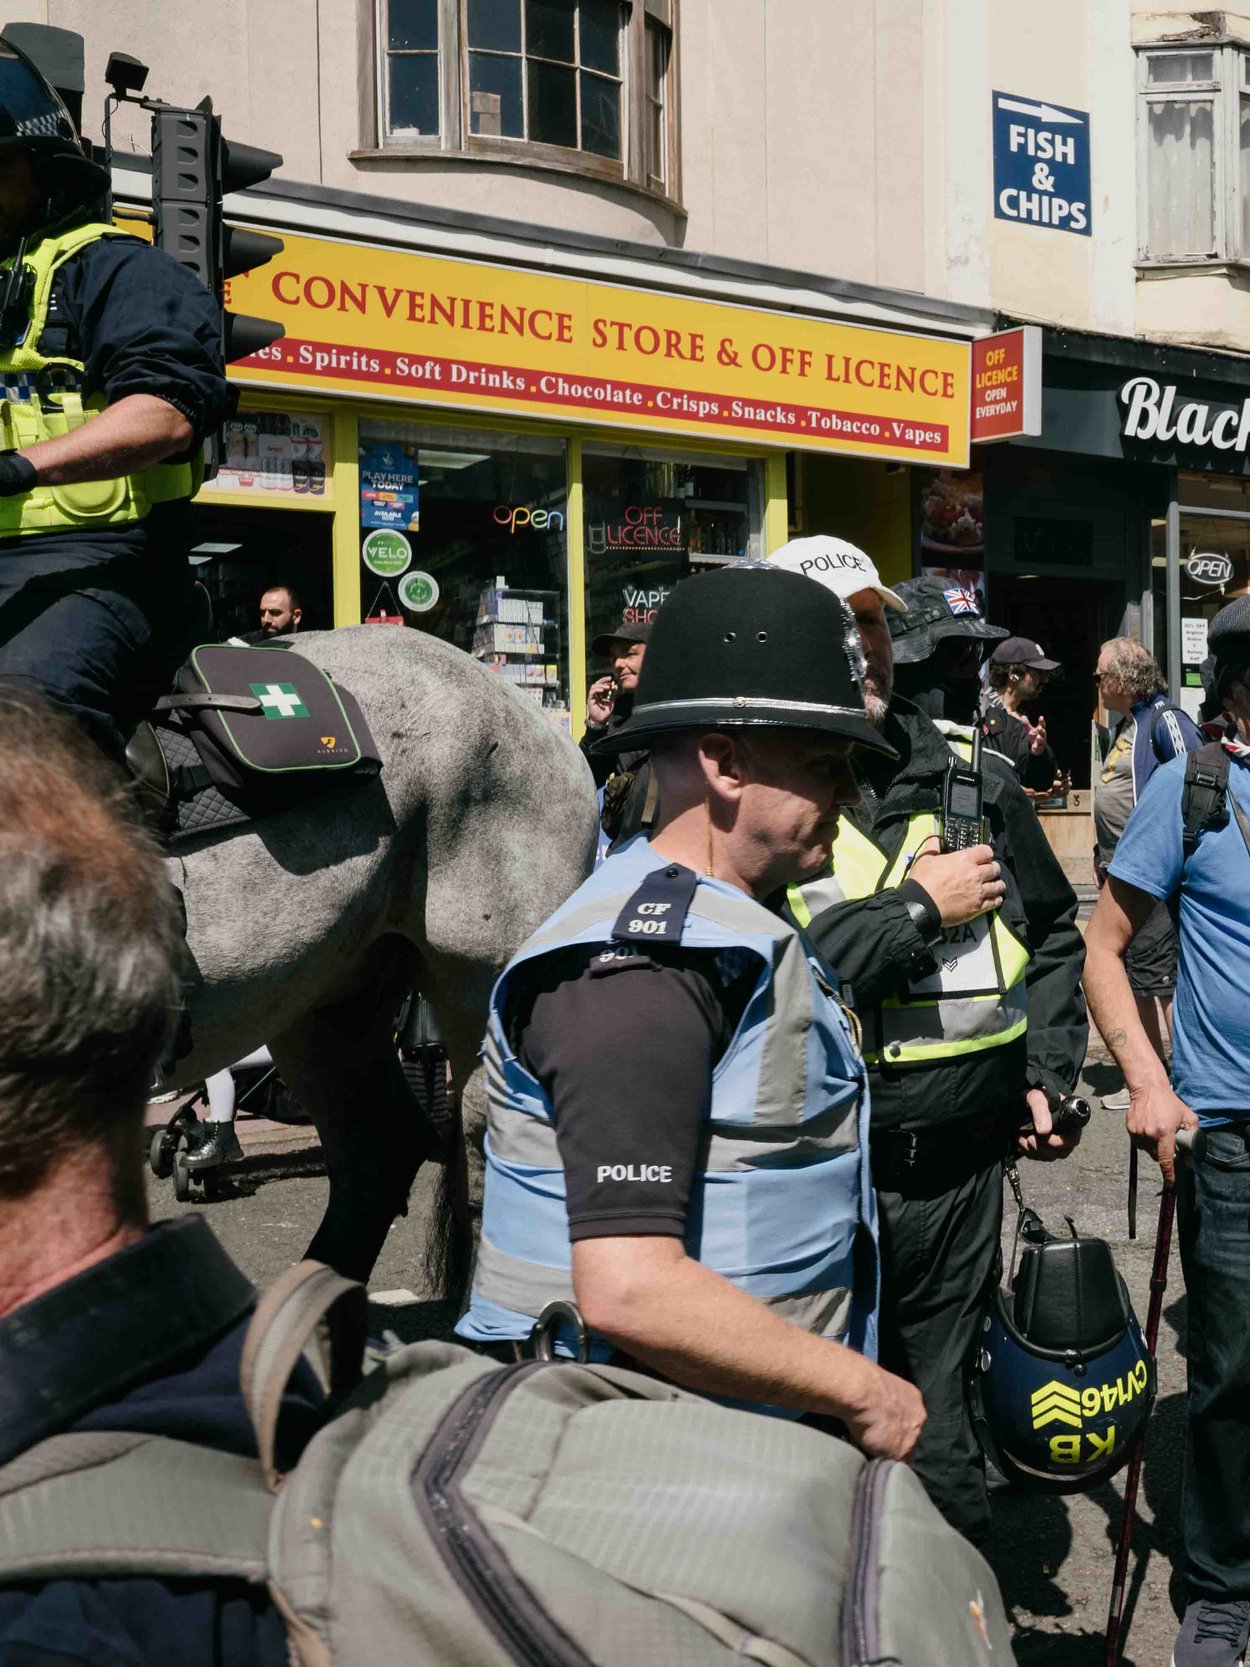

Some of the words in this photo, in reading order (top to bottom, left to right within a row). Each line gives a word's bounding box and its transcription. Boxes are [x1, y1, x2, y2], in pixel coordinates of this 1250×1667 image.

[1009, 124, 1075, 164] FISH
[1031, 163, 1055, 191] &
[999, 188, 1087, 230] CHIPS
[271, 271, 573, 343] CONVENIENCE
[593, 317, 704, 363] STORE
[716, 339, 742, 368] &
[752, 344, 812, 378] OFF
[825, 354, 955, 399] LICENCE
[985, 349, 1005, 368] OFF
[976, 365, 1018, 387] LICENCE
[299, 344, 380, 373] Spirits
[396, 356, 441, 382] Soft
[450, 362, 525, 391] Drinks
[540, 375, 643, 406] Chocolate
[656, 391, 719, 417] Crisps
[731, 402, 795, 425] Snacks
[808, 411, 880, 436] Tobacco
[891, 423, 941, 445] Vapes
[985, 388, 1006, 401] OPEN
[975, 400, 1018, 419] EVERYDAY
[362, 470, 387, 481] PLAY
[388, 472, 414, 483] HERE
[371, 480, 405, 491] TODAY
[800, 552, 867, 576] POLICE
[1187, 557, 1232, 580] OPEN
[637, 903, 671, 915] CF
[628, 919, 668, 935] 901
[596, 1163, 672, 1184] POLICE
[1081, 1359, 1148, 1418] CV146
[1049, 1425, 1116, 1464] KB
